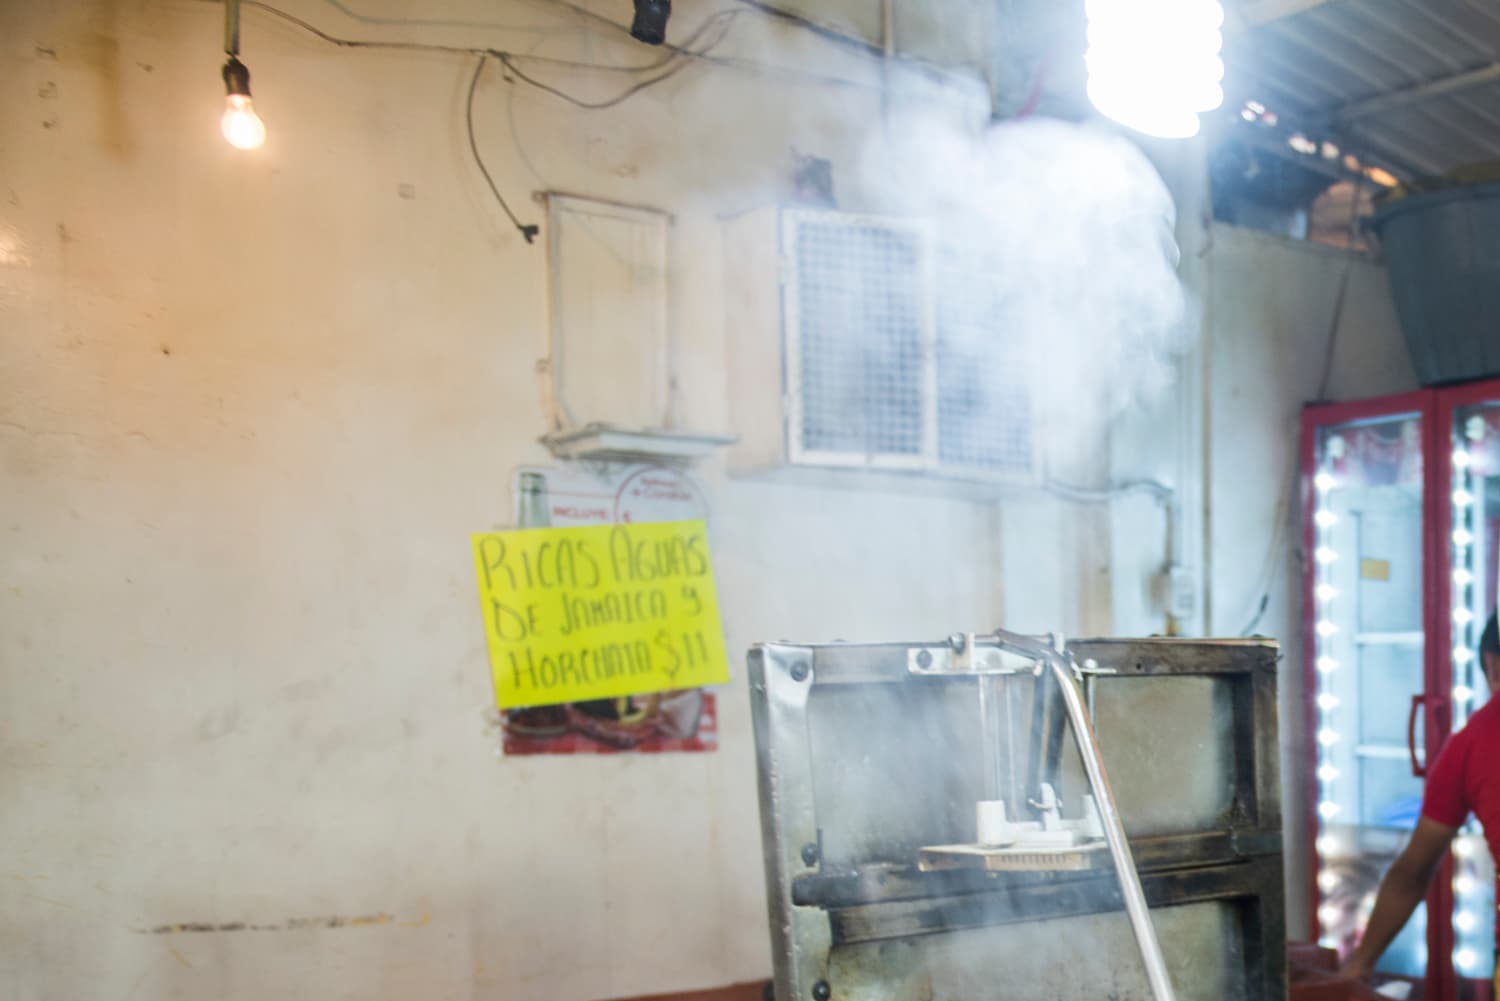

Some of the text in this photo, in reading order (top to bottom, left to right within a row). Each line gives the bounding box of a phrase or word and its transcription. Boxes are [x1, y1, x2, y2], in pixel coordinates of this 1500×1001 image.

[479, 525, 708, 592] RICAS AGUAS
[490, 597, 544, 643] DE
[560, 588, 668, 636] JAMAICA
